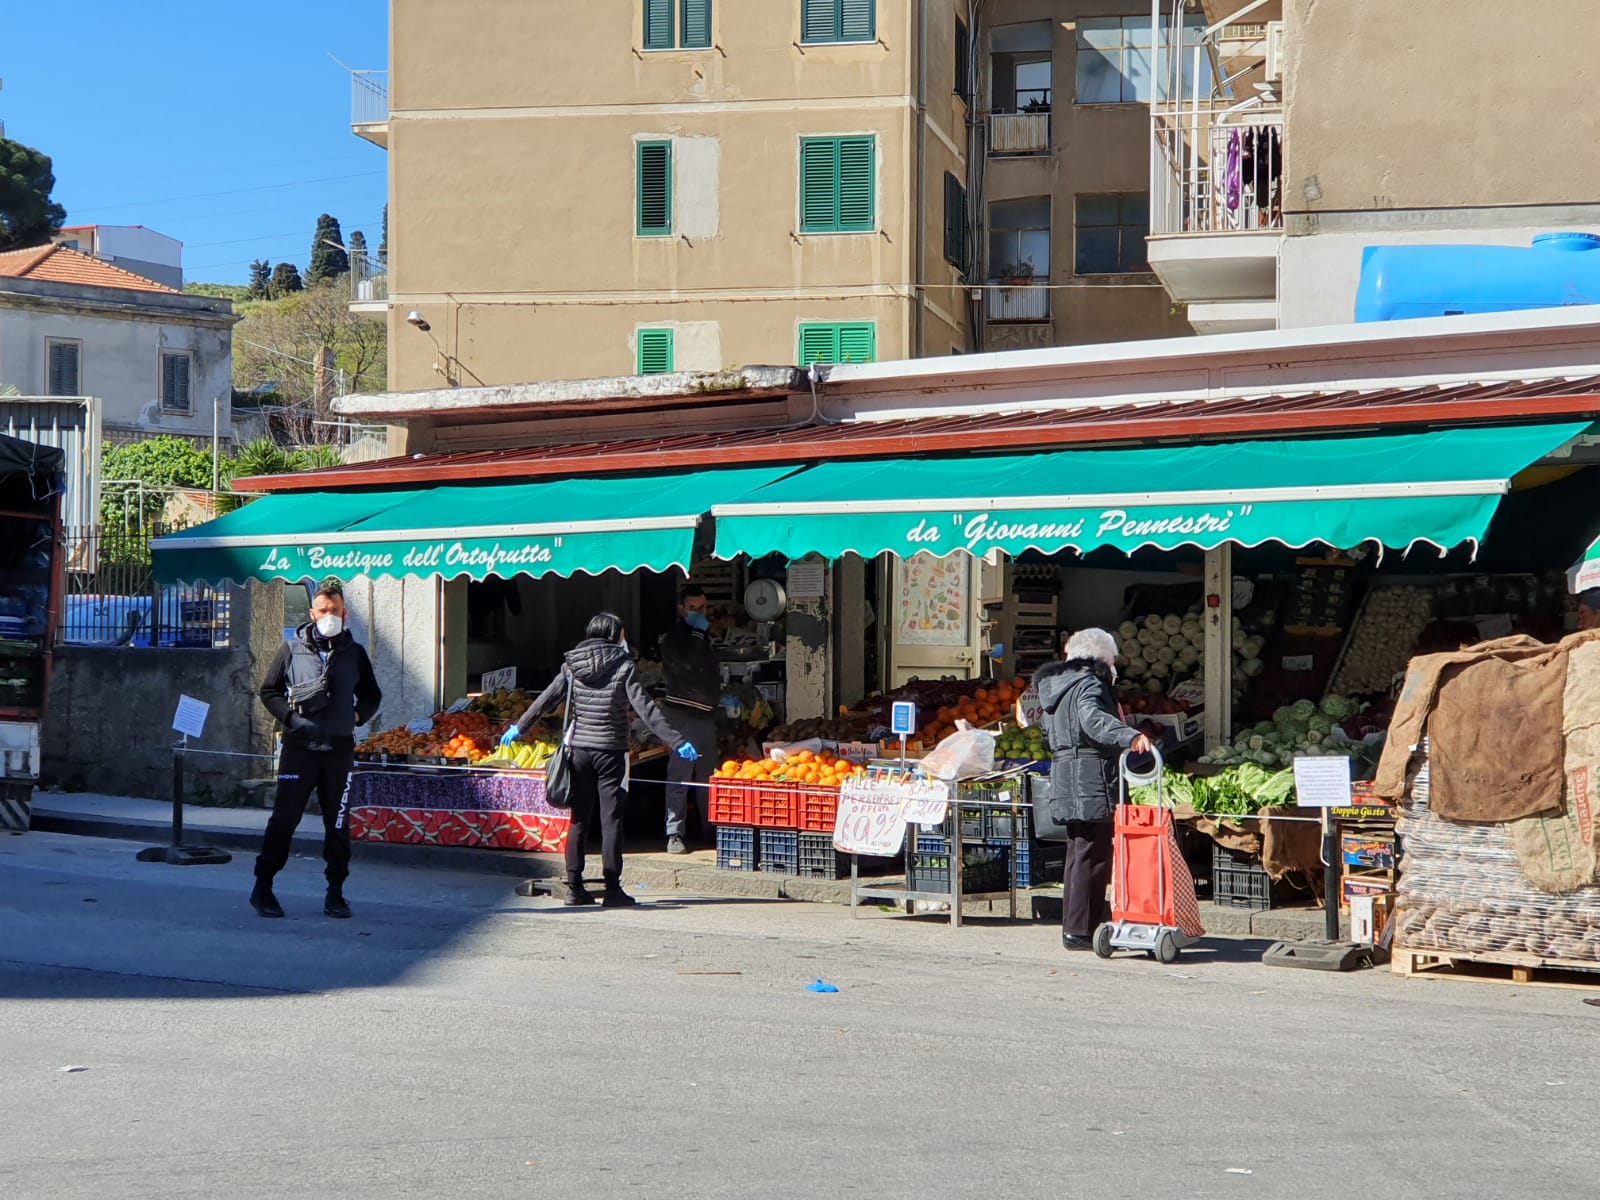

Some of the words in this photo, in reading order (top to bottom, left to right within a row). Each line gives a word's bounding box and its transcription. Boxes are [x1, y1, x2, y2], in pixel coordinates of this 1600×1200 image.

[906, 518, 941, 542] da
[953, 513, 1086, 549] "Giovanni
[259, 548, 291, 571] La
[297, 546, 393, 574] "Boutique
[402, 536, 563, 571] dell'Ortofrutta"
[1331, 806, 1359, 818] Doppio
[1360, 806, 1385, 818] Gusto
